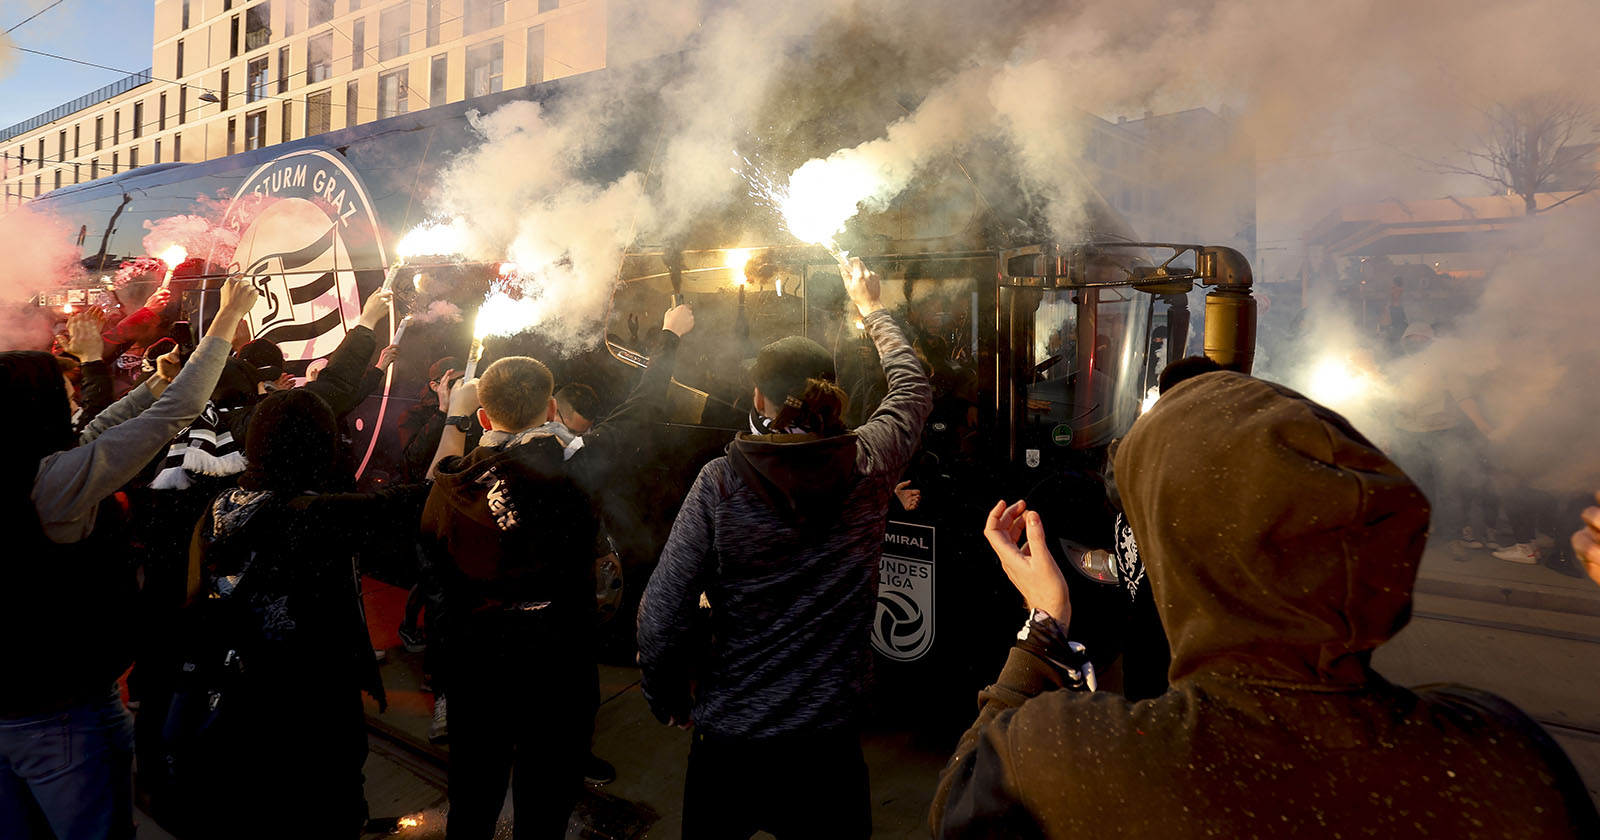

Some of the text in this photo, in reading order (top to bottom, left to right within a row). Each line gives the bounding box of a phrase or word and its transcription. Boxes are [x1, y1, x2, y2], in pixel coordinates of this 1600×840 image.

[231, 164, 357, 232] SK STURM GRAZ
[884, 532, 929, 550] MIRAL
[879, 560, 928, 579] UNDES
[879, 573, 914, 590] LIGA
